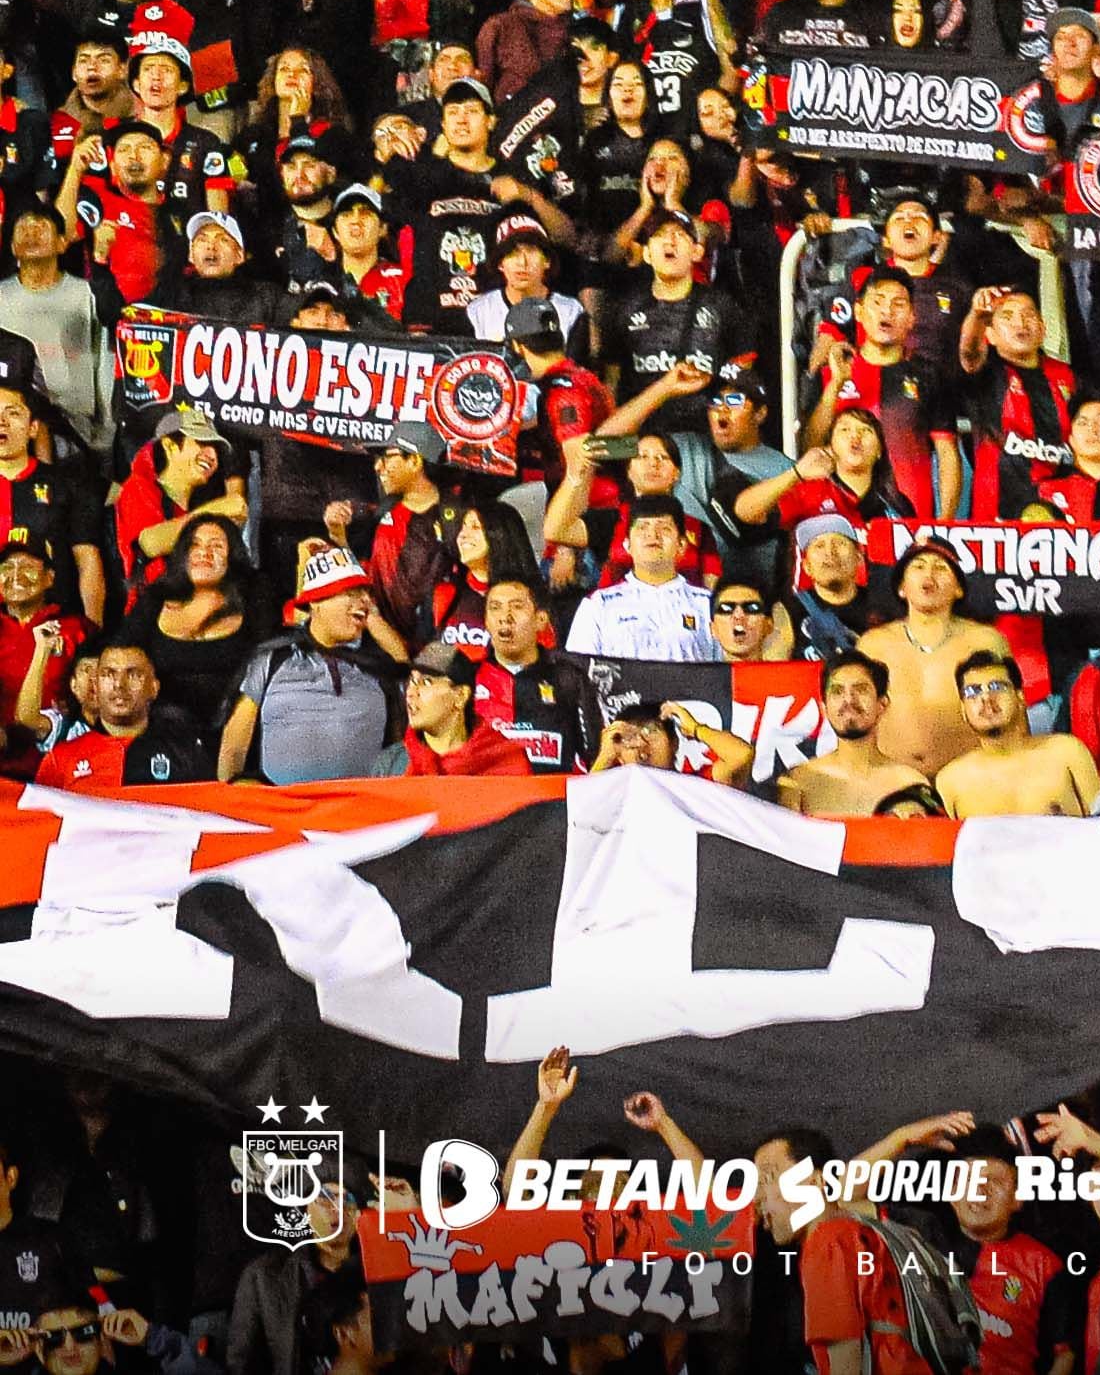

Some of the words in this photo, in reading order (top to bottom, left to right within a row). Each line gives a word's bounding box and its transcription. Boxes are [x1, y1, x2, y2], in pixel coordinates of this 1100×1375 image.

[182, 323, 309, 409] CONO
[313, 339, 436, 424] ESTE
[221, 407, 264, 427] CONO
